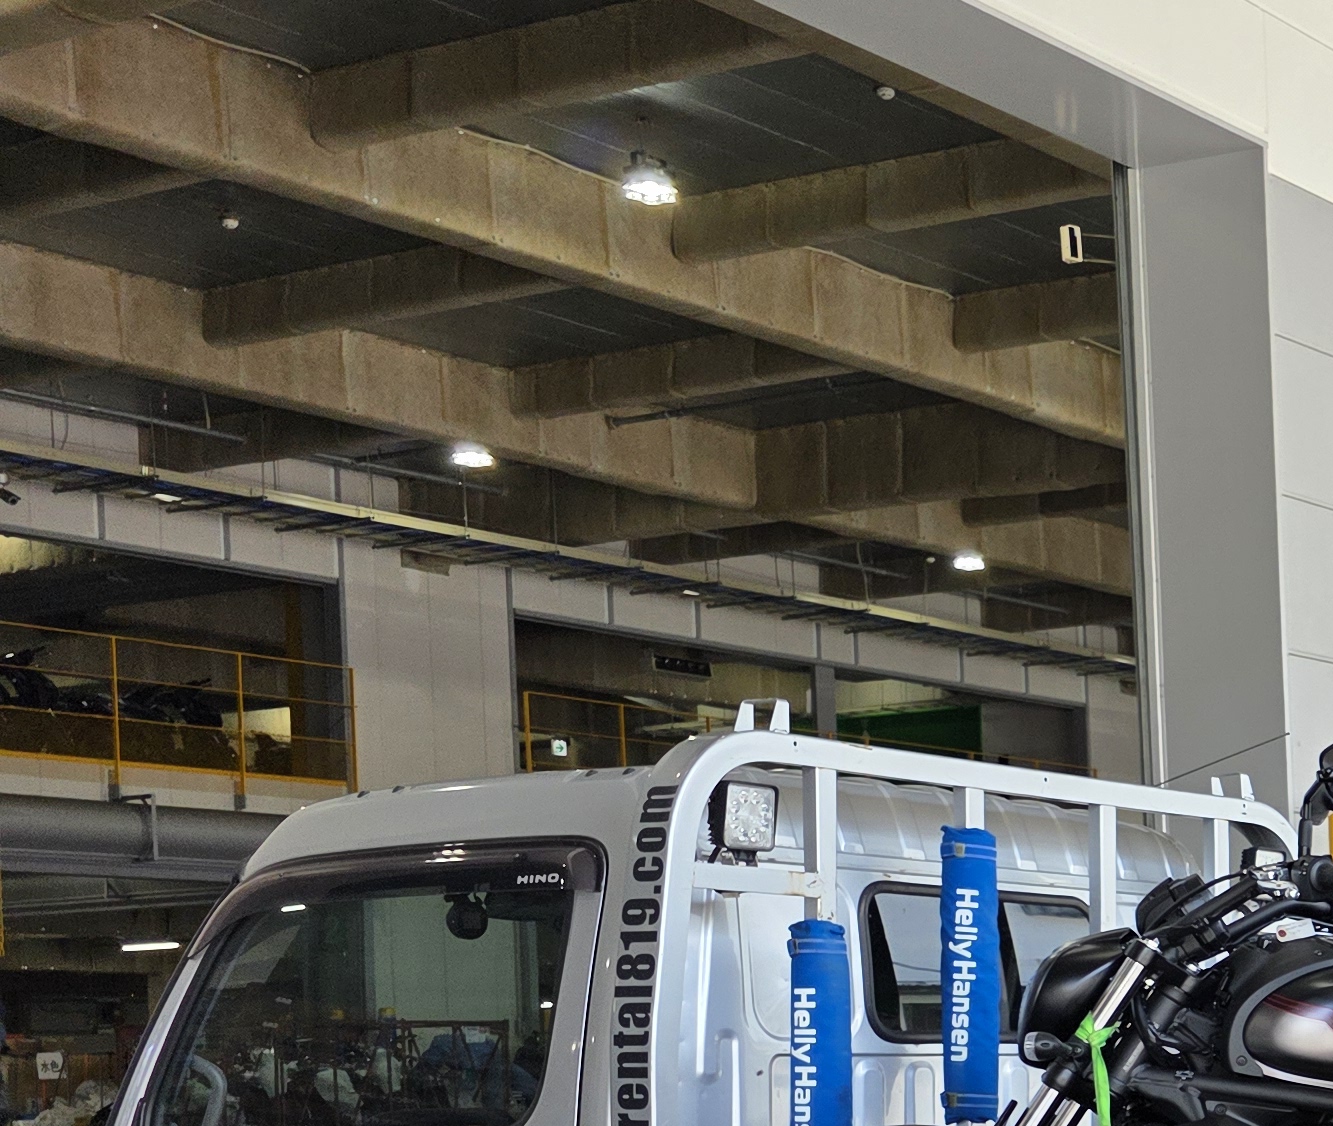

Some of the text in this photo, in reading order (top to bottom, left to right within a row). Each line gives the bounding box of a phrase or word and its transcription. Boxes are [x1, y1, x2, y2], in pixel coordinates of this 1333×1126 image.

[516, 872, 560, 885] HINO
[948, 888, 980, 1062] Helly Hansen
[791, 987, 817, 1064] Helly
